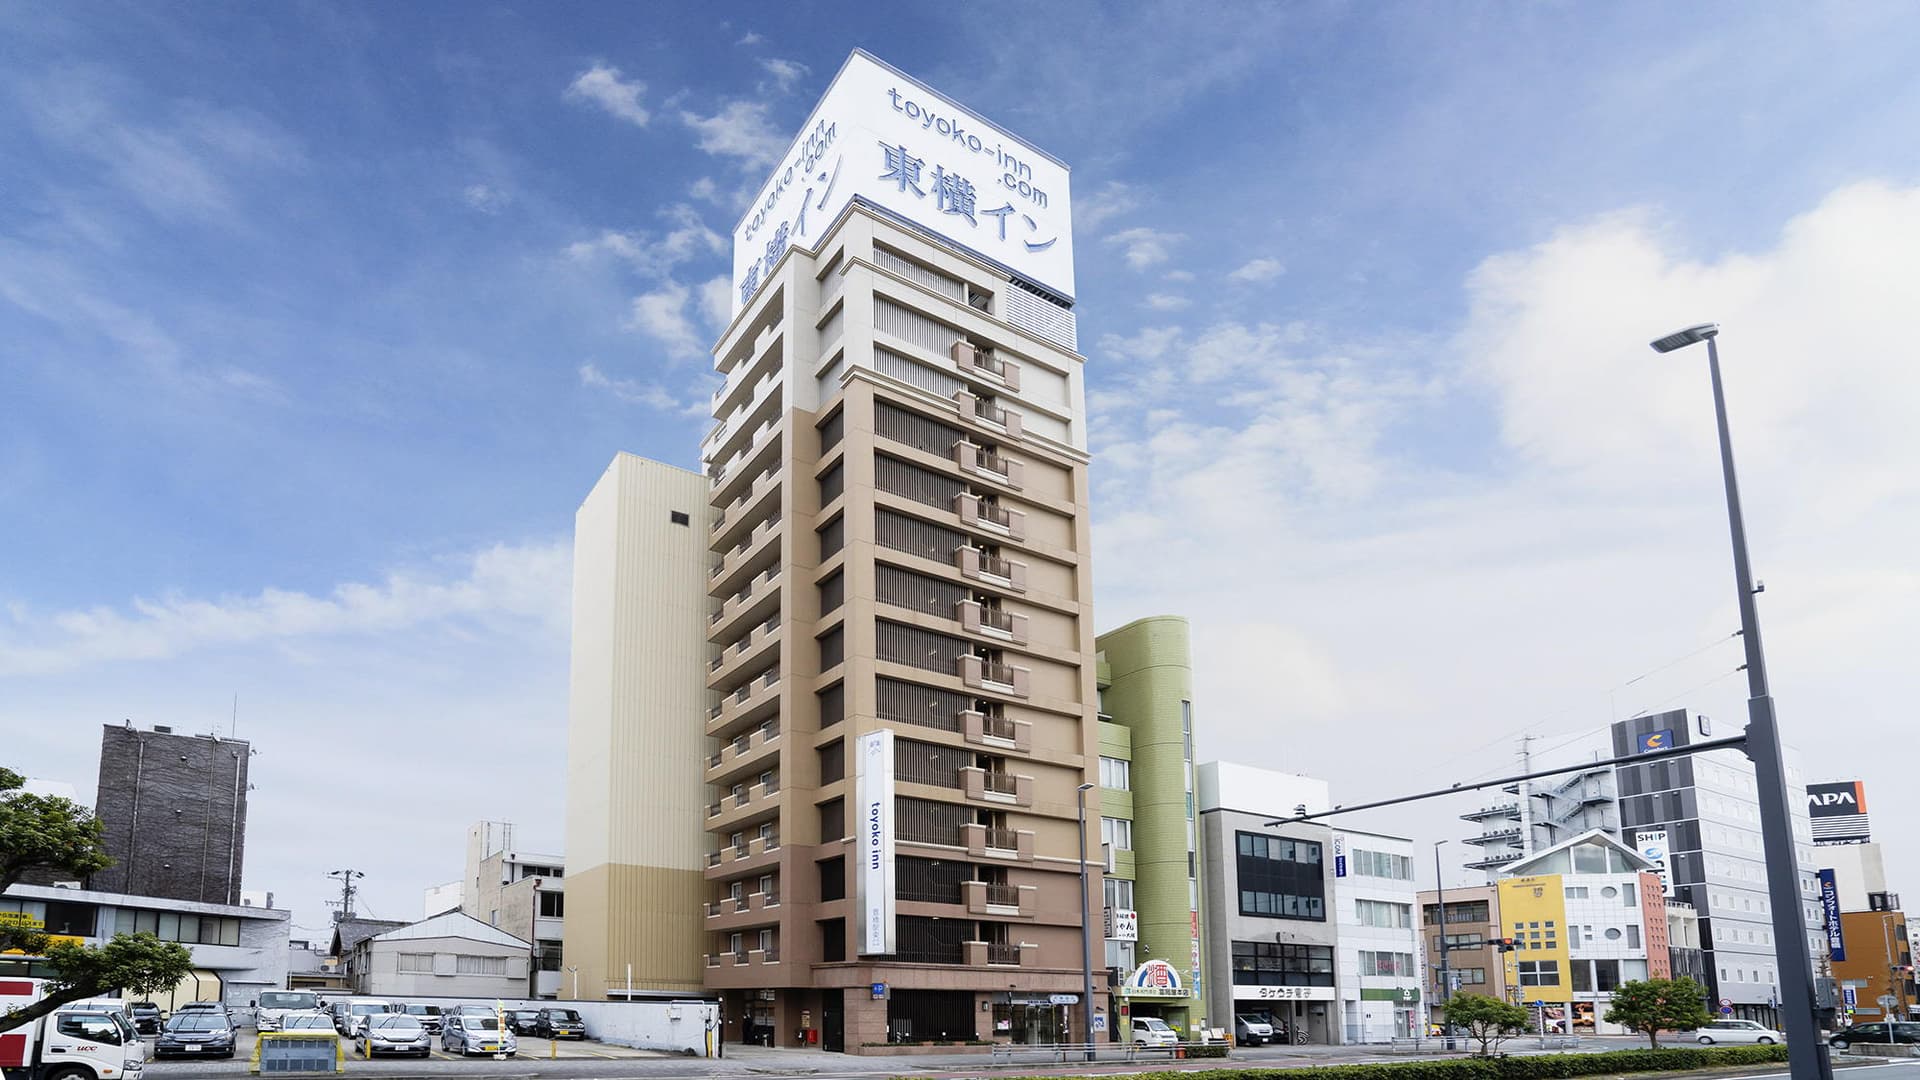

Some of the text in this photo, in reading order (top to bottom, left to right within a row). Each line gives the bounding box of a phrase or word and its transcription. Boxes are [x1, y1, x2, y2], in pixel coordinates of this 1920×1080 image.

[801, 122, 837, 183] .com
[888, 87, 1033, 181] toyoko-inn
[744, 119, 826, 241] toyoko-inn
[878, 141, 1058, 253] 東横イン
[997, 176, 1048, 208] .com
[1807, 791, 1856, 806] APA
[870, 802, 882, 870] toyoko inn
[1637, 832, 1666, 842] SHIP
[1147, 964, 1168, 986] 酒
